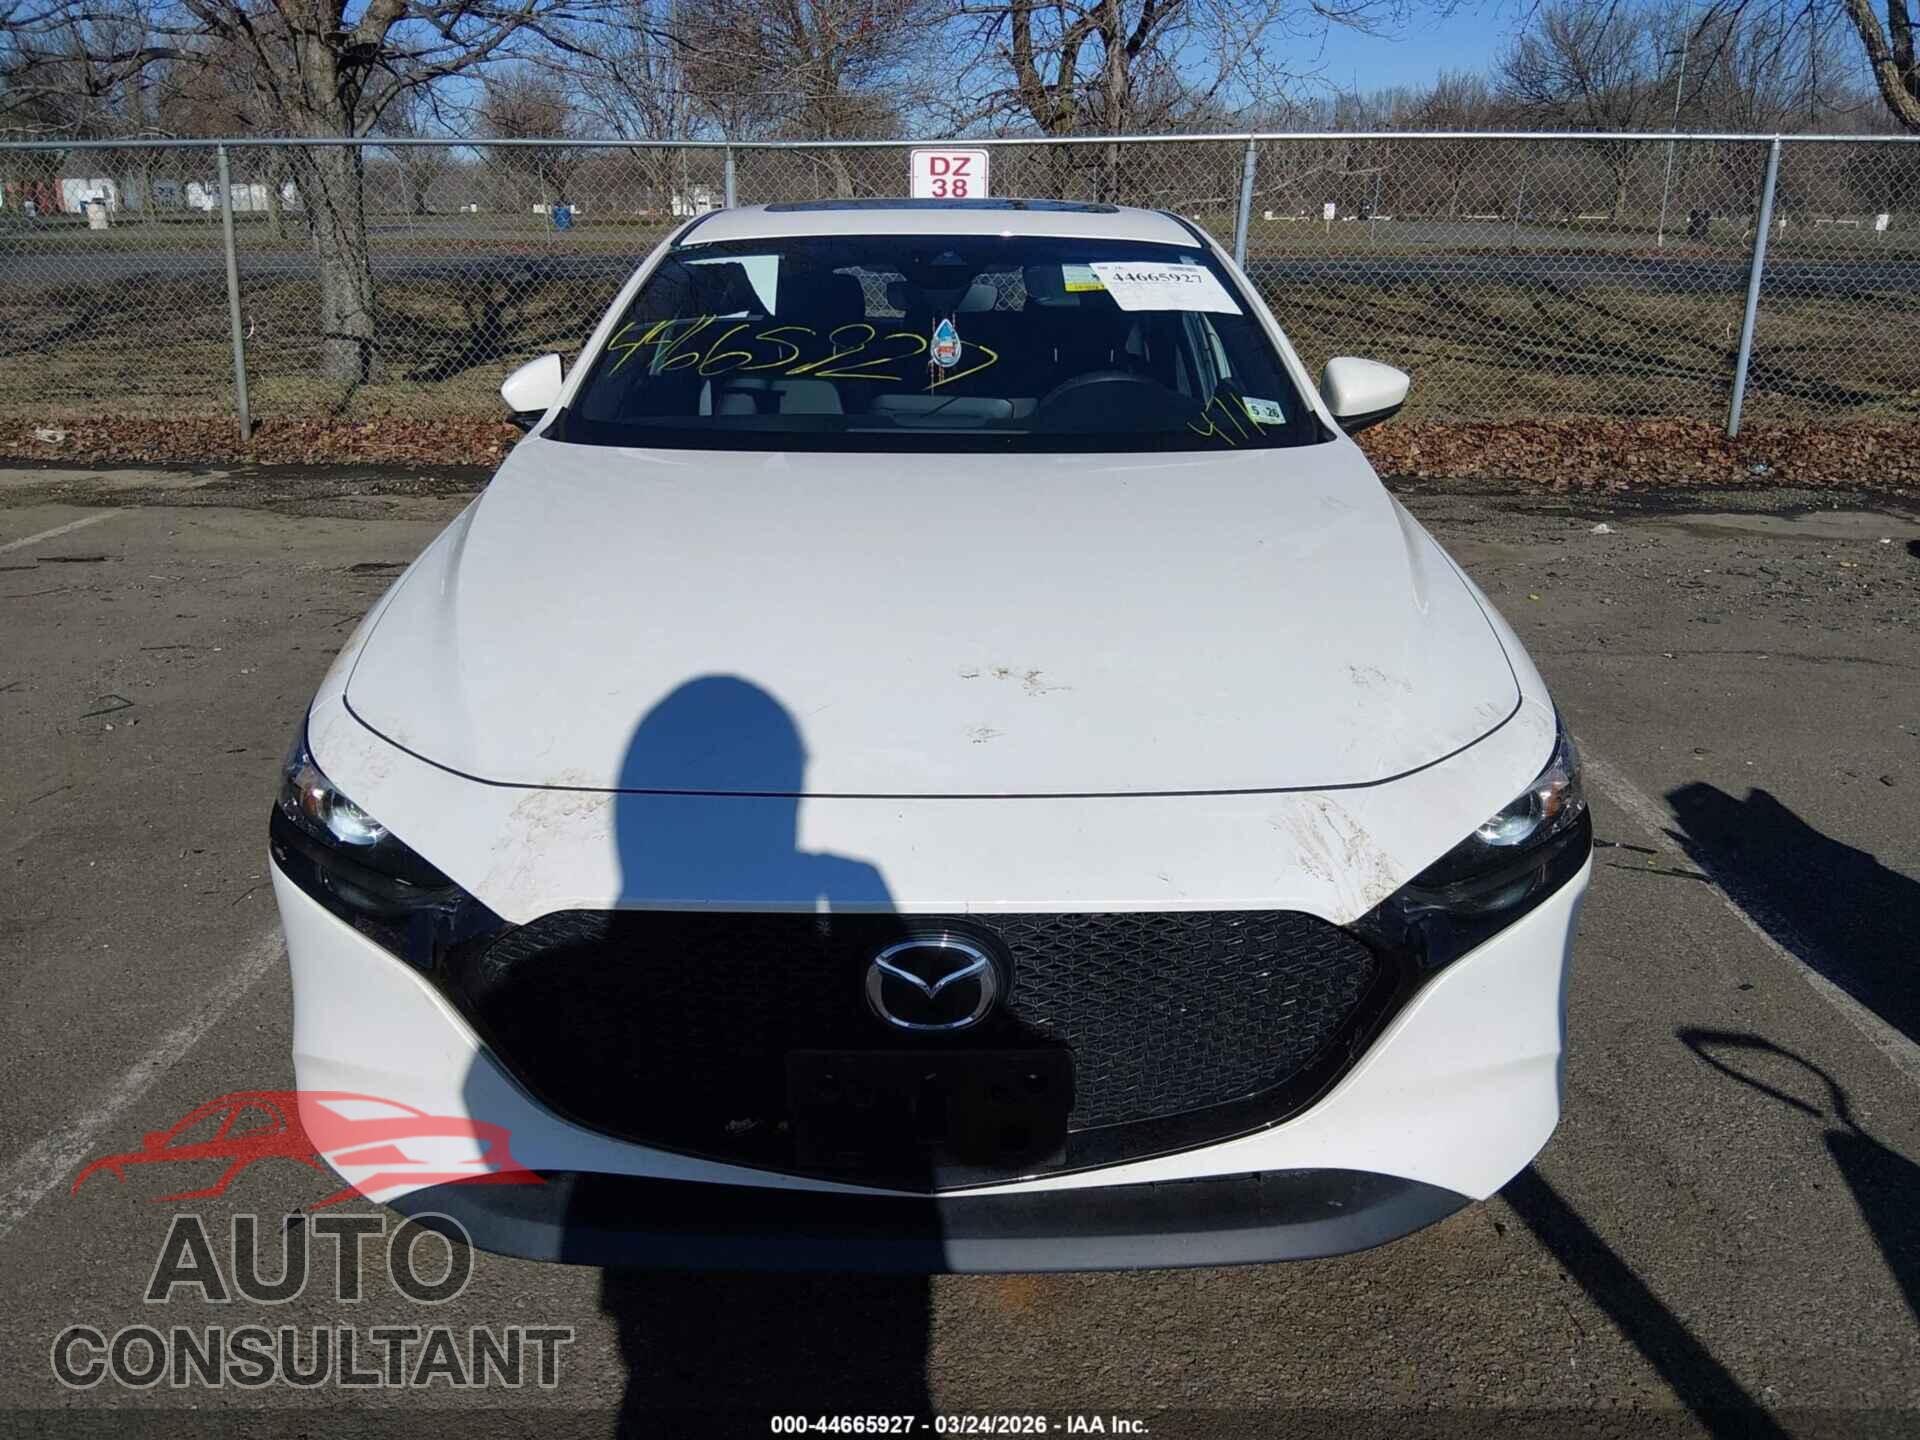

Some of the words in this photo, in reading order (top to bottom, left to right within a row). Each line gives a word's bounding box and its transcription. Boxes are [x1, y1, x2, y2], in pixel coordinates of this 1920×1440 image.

[929, 156, 971, 176] DZ
[932, 178, 968, 197] 38
[1112, 272, 1203, 283] 44665927
